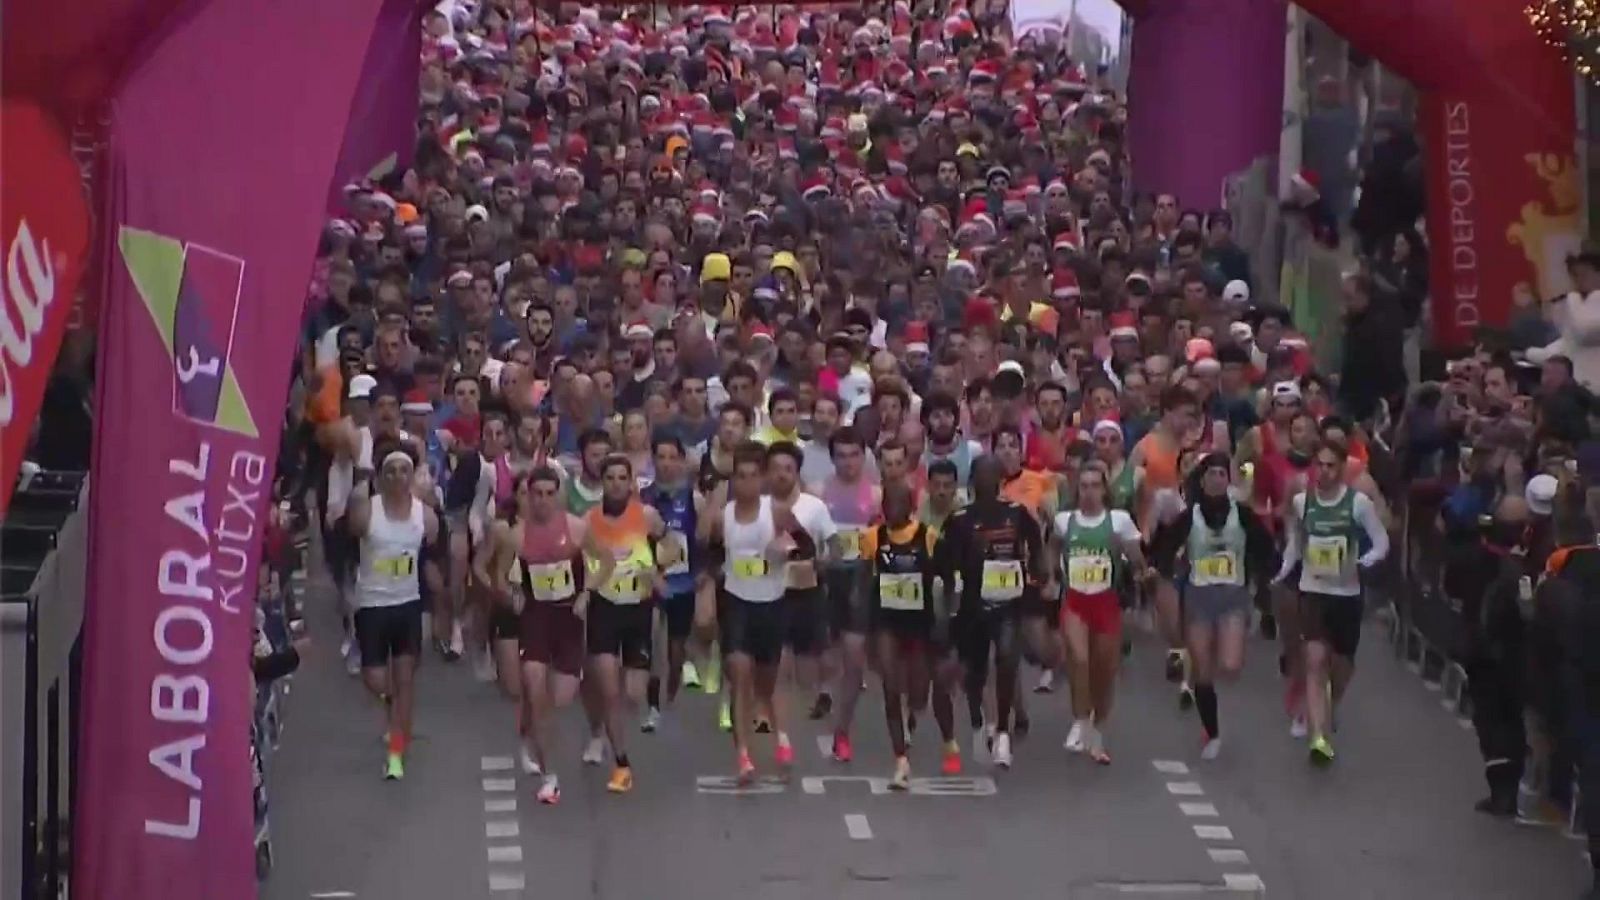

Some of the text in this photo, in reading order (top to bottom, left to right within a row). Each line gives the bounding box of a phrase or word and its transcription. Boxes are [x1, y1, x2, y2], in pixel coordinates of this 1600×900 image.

[1445, 101, 1479, 327] DE DEPORTES
[144, 441, 214, 840] LABORAL
